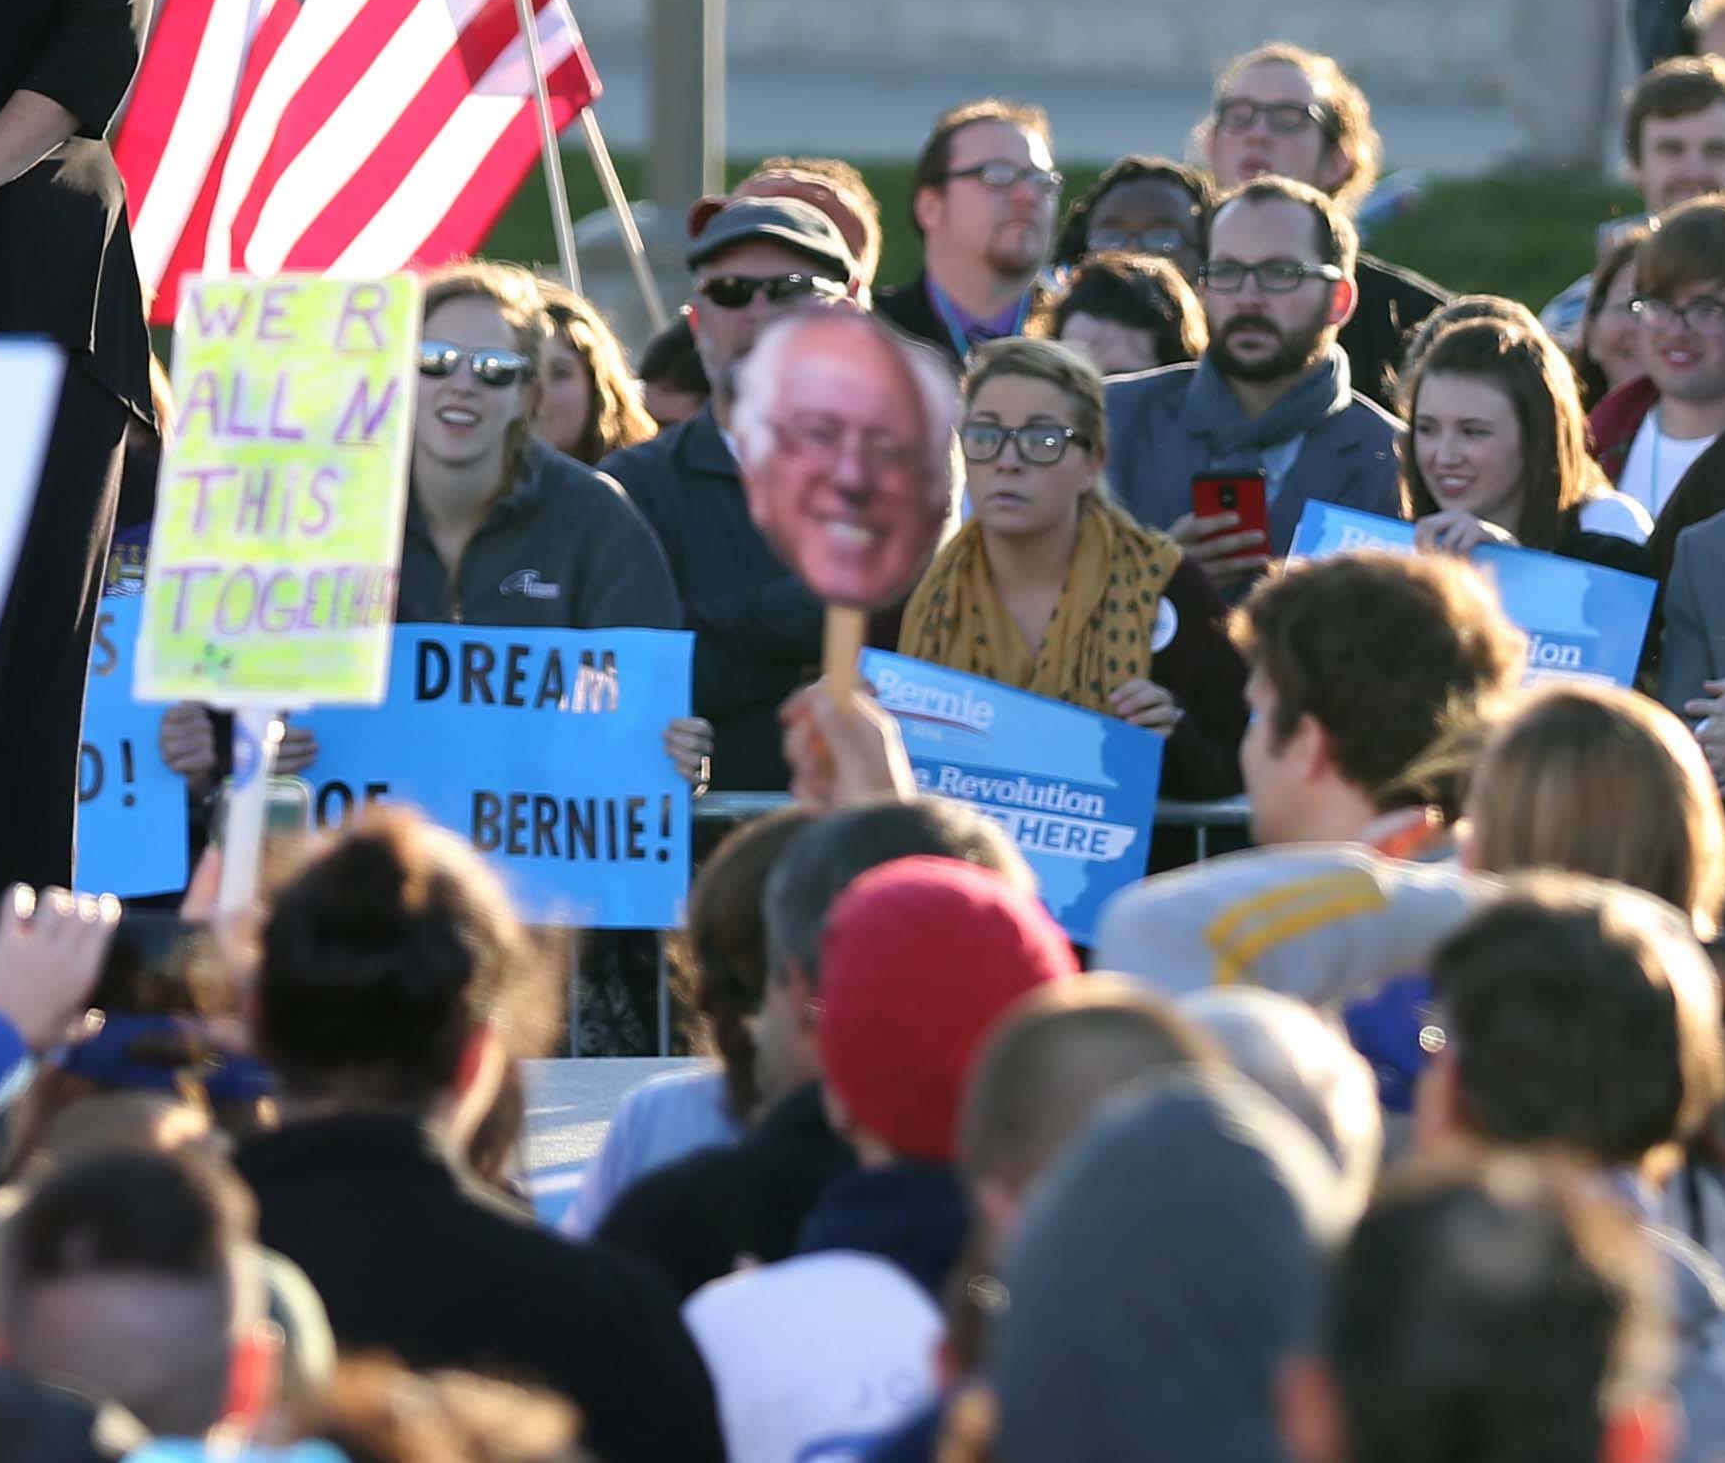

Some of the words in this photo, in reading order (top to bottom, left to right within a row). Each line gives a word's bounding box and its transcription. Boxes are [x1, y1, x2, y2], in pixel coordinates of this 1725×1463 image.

[190, 284, 298, 341] WE
[334, 283, 394, 352] R
[175, 370, 305, 440] ALL
[334, 376, 400, 442] N
[415, 640, 620, 713] DREAM
[876, 668, 995, 728] Bernie
[940, 765, 1106, 817] Revolution
[471, 789, 672, 863] BERNIE!
[1016, 818, 1111, 856] HERE
